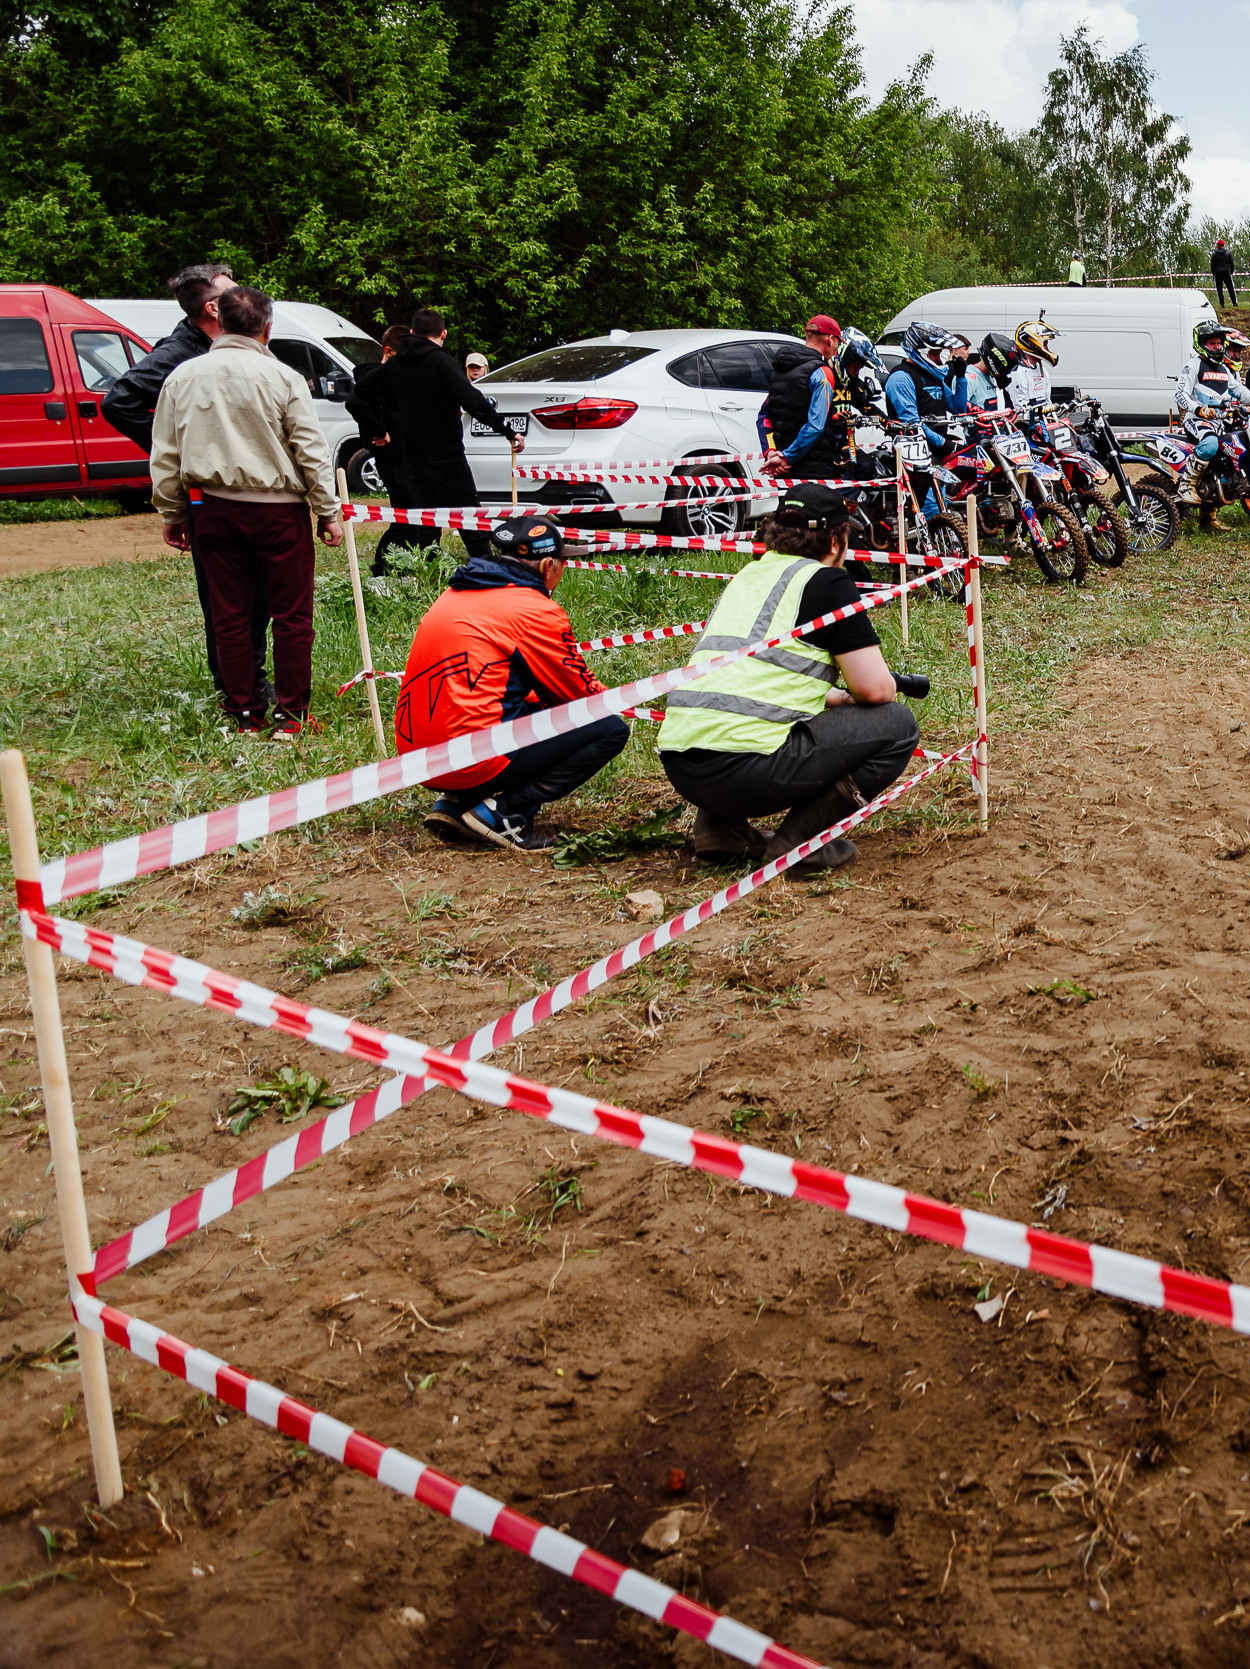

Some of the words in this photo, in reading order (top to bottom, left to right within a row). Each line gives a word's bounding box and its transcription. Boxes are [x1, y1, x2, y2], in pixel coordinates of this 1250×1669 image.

[1053, 427, 1072, 451] 2
[1003, 441, 1027, 456] 737
[1160, 445, 1178, 463] 84
